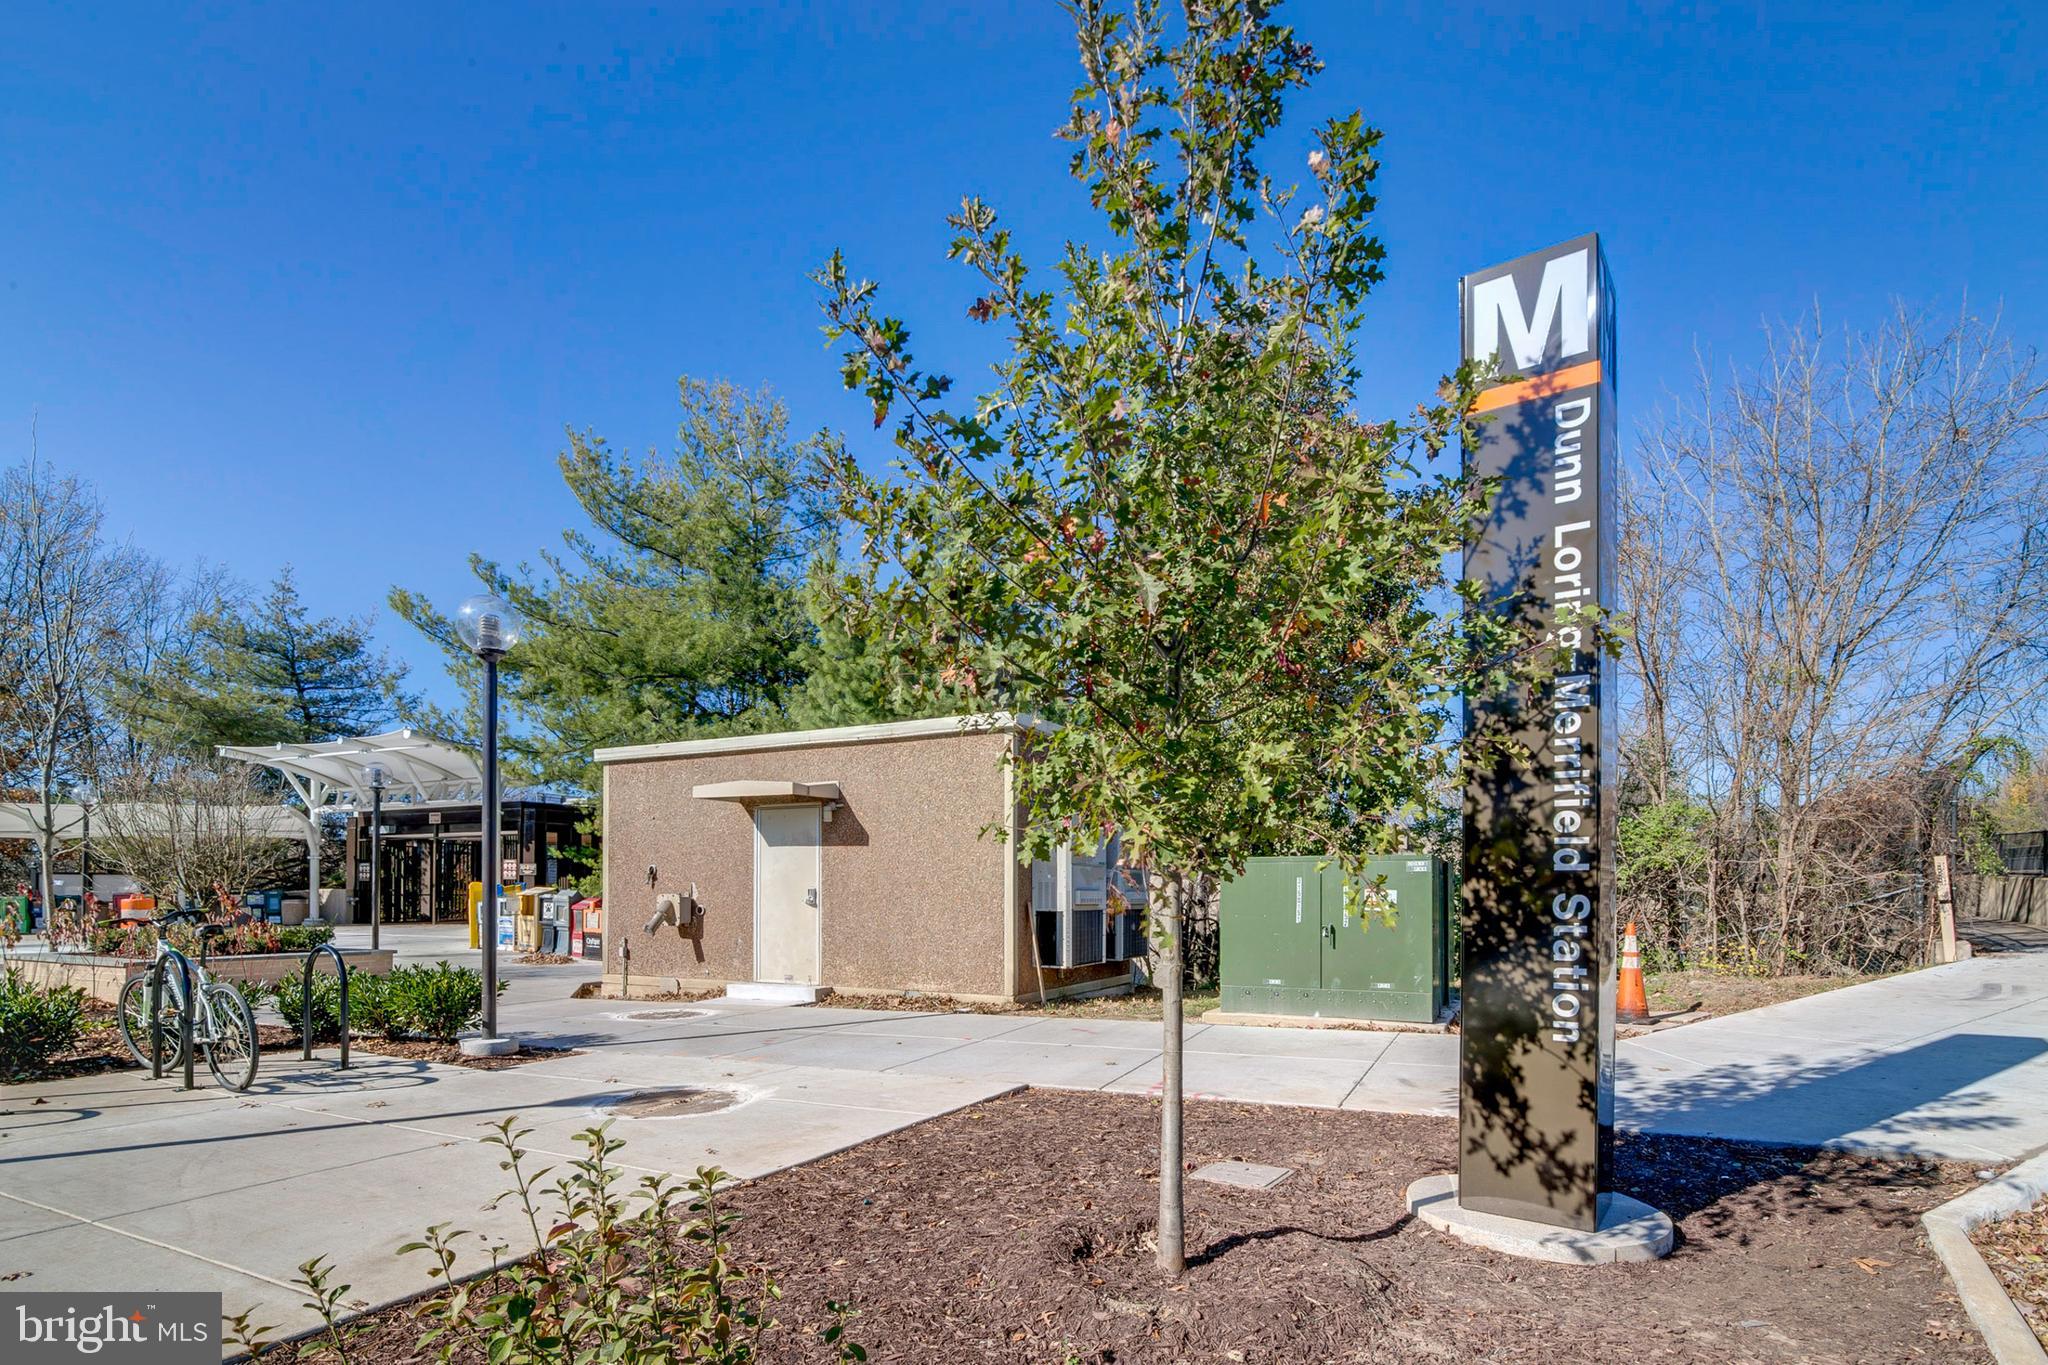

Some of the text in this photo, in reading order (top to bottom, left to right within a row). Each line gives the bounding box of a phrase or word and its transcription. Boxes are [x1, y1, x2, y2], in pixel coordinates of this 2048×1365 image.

[1473, 248, 1589, 382] M
[1554, 397, 1591, 504] Dunn
[1552, 893, 1591, 1042] Station
